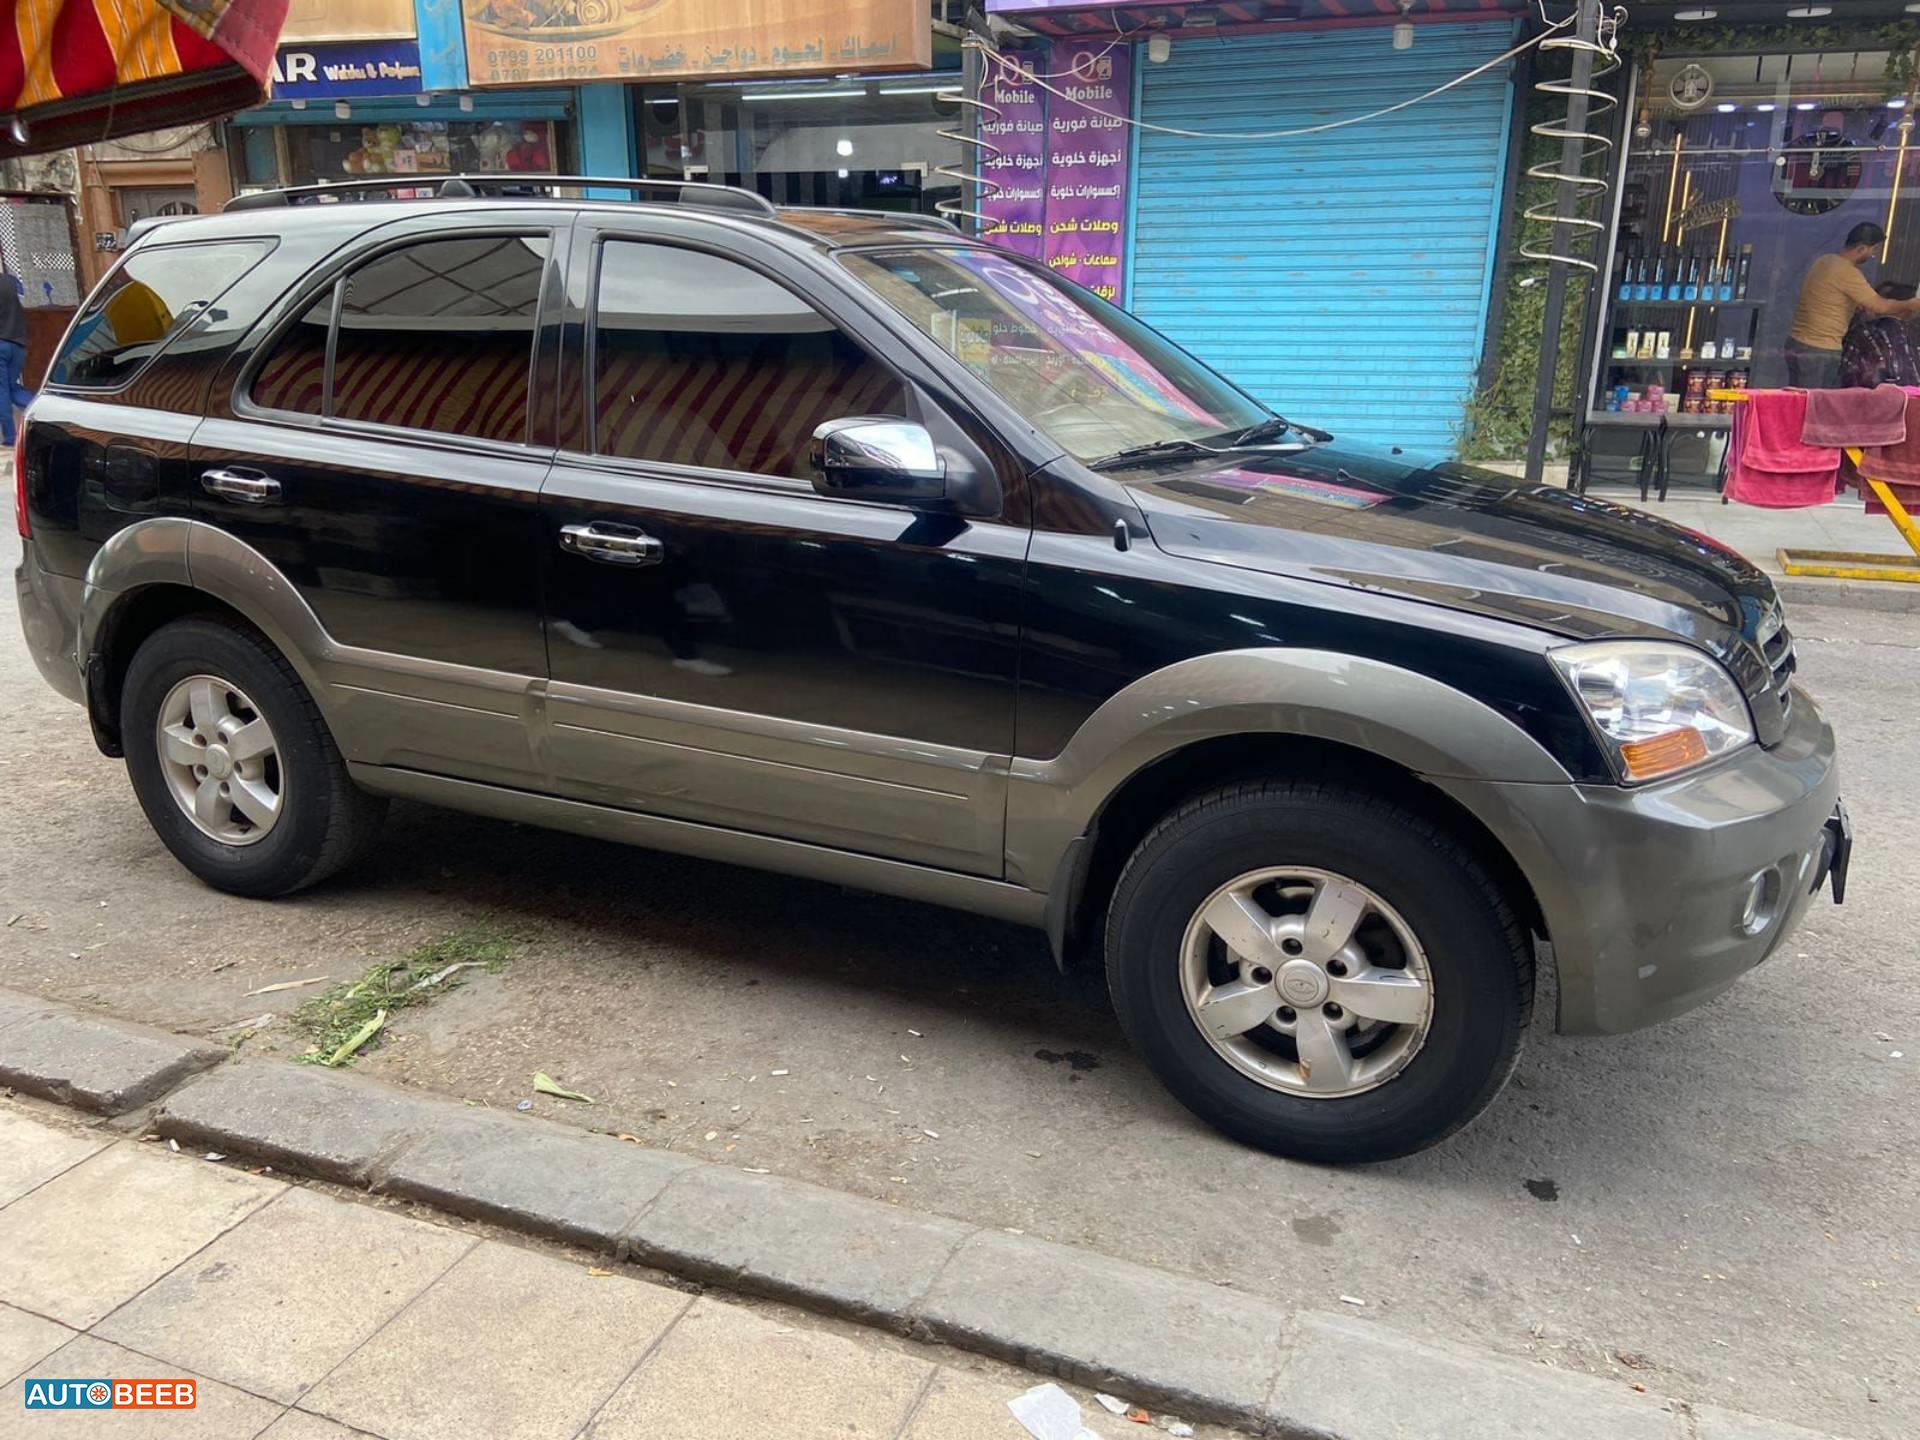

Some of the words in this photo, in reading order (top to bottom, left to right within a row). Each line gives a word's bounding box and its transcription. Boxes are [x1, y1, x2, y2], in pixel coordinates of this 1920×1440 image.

[488, 50, 529, 67] 0799
[535, 46, 597, 64] 201100
[996, 89, 1035, 104] Mobile
[1065, 85, 1113, 101] Mobile
[1053, 117, 1087, 133] فورية
[1090, 115, 1123, 131] صيانة
[1052, 152, 1086, 167] خلوية
[1089, 149, 1122, 166] أجهزة
[1050, 184, 1074, 200] خلوية
[1076, 184, 1121, 200] إكسسوارات
[1010, 220, 1042, 236] وصلات
[1050, 217, 1078, 234] شحن
[1080, 219, 1119, 234] وصلات
[1049, 252, 1078, 268] شواحن
[1083, 253, 1118, 266] سماعات
[992, 322, 1008, 336] خلو
